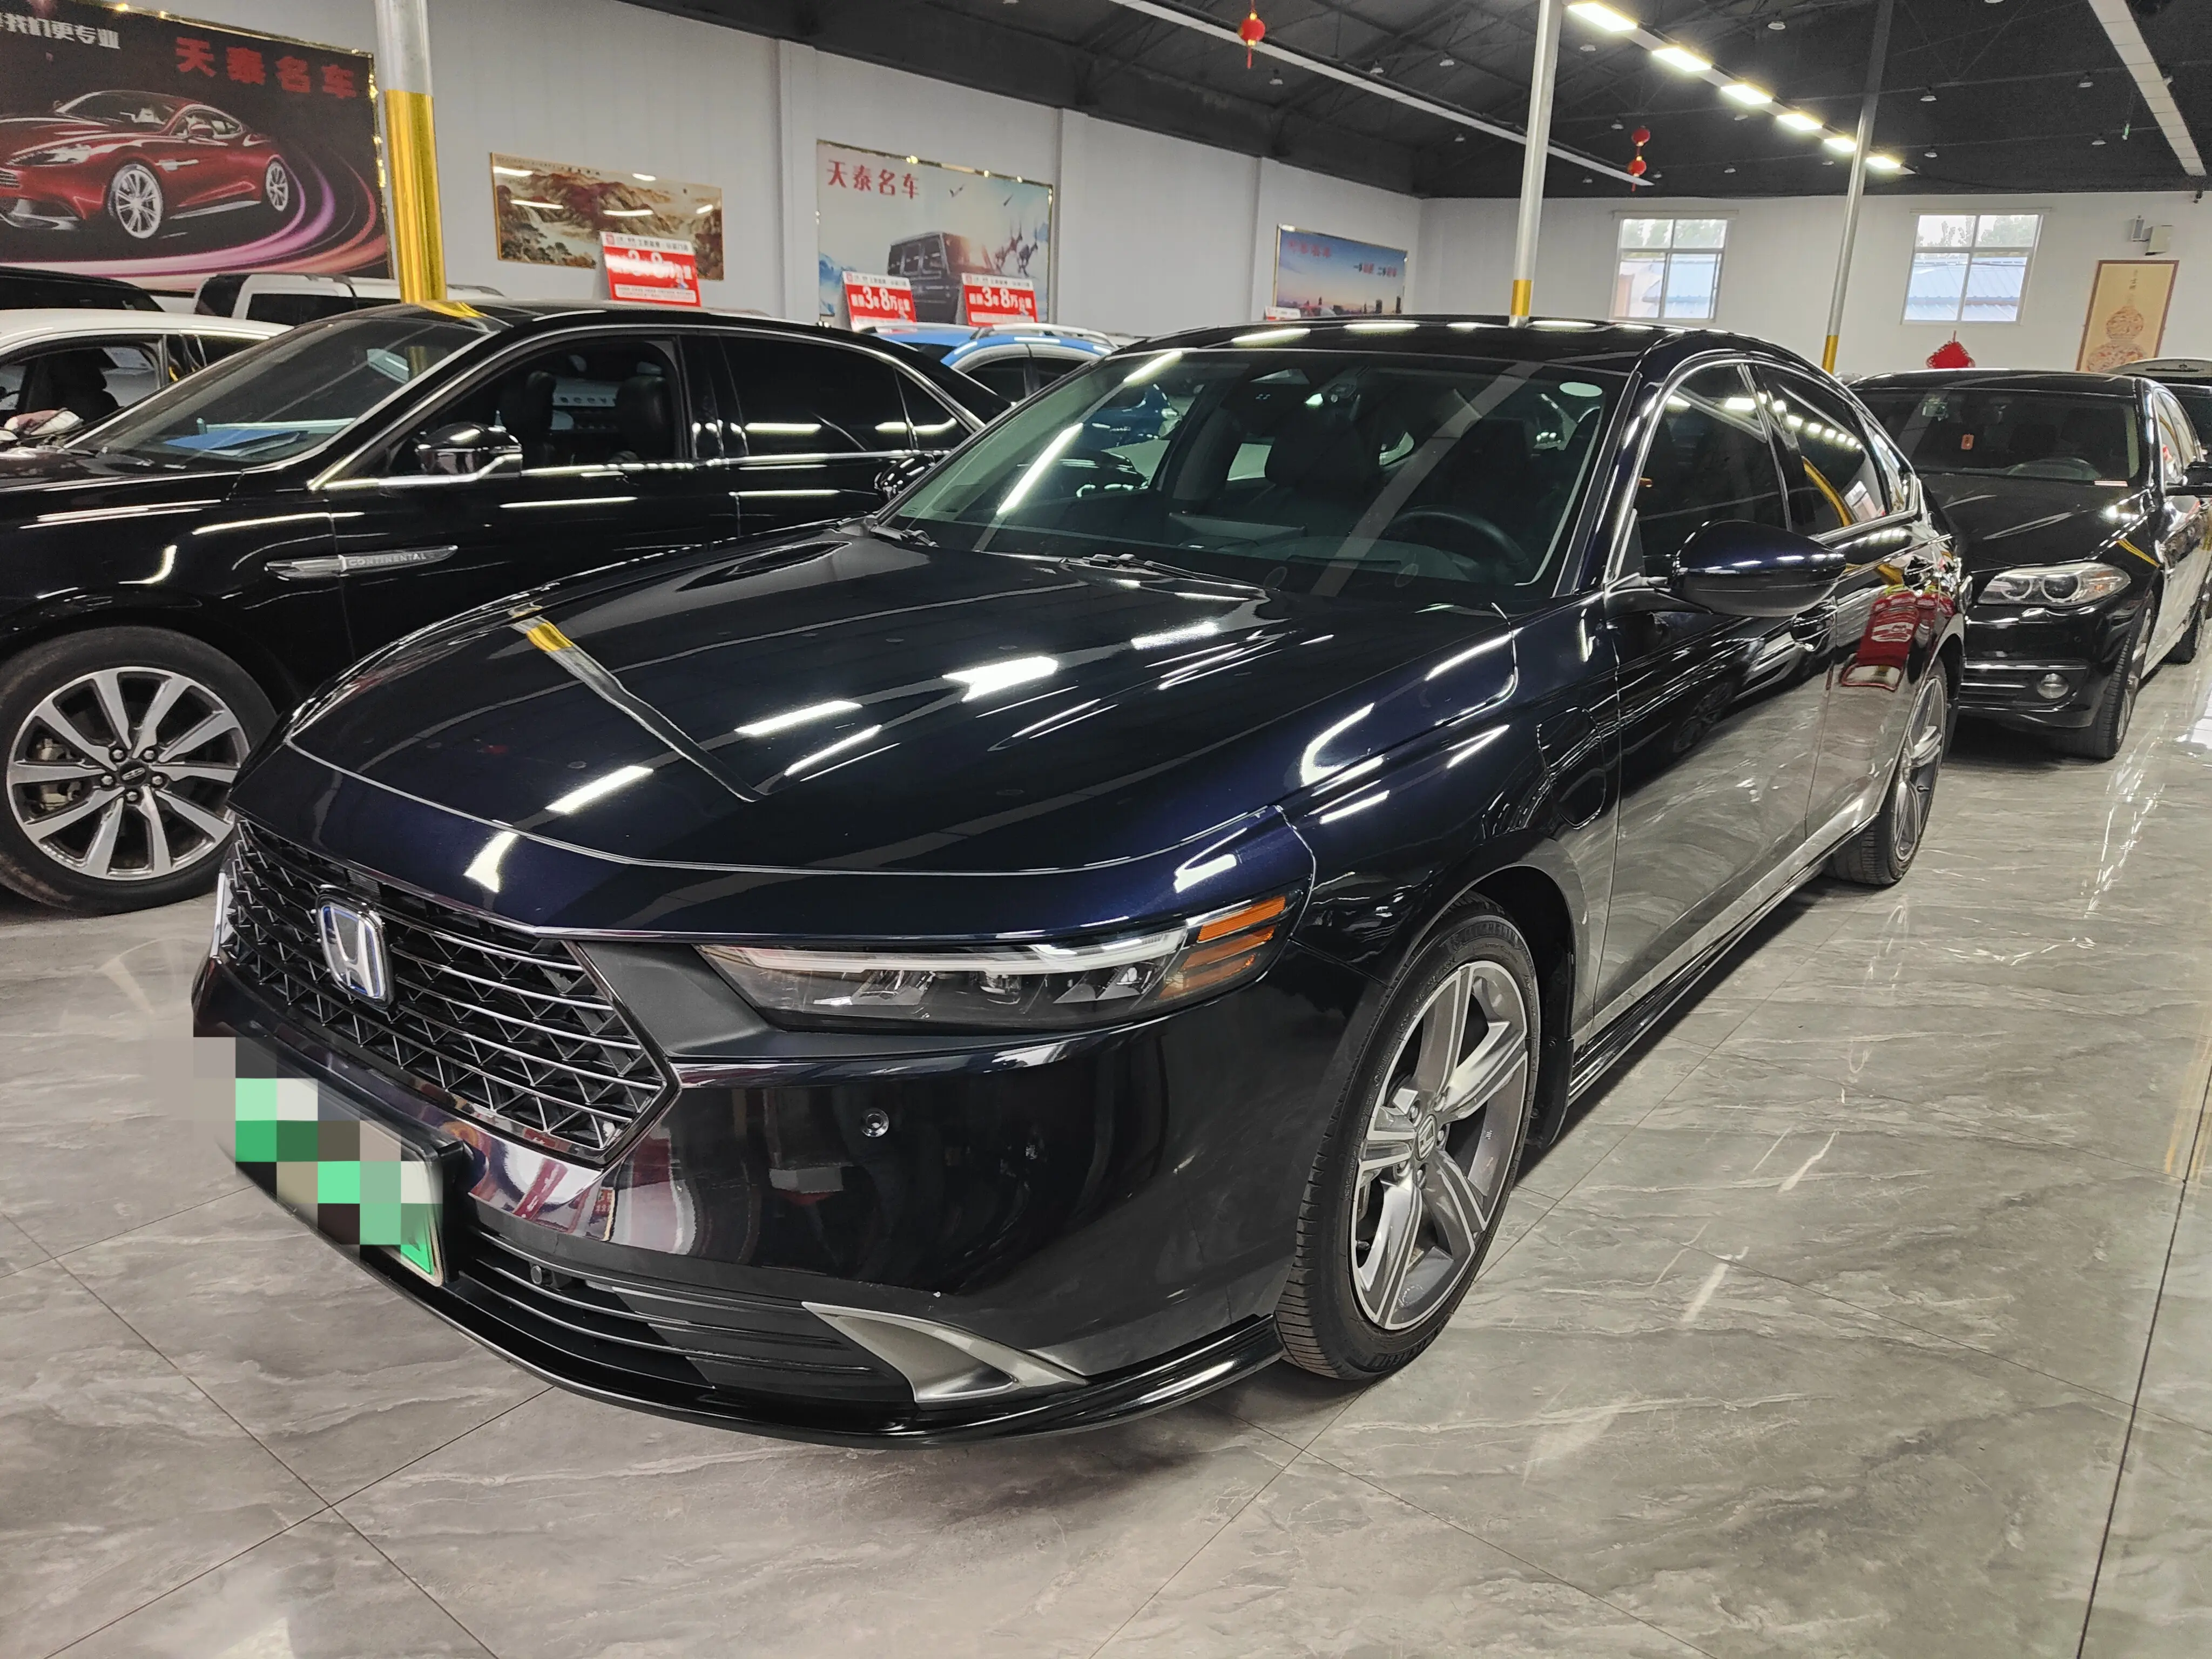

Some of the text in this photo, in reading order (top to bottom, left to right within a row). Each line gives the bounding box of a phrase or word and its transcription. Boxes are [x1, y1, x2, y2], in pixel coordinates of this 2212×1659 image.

[0, 12, 121, 50] 我们更专业
[174, 36, 358, 99] 天泰名车
[826, 158, 920, 200] 天泰名车
[348, 553, 427, 567] CONTINENTAL
